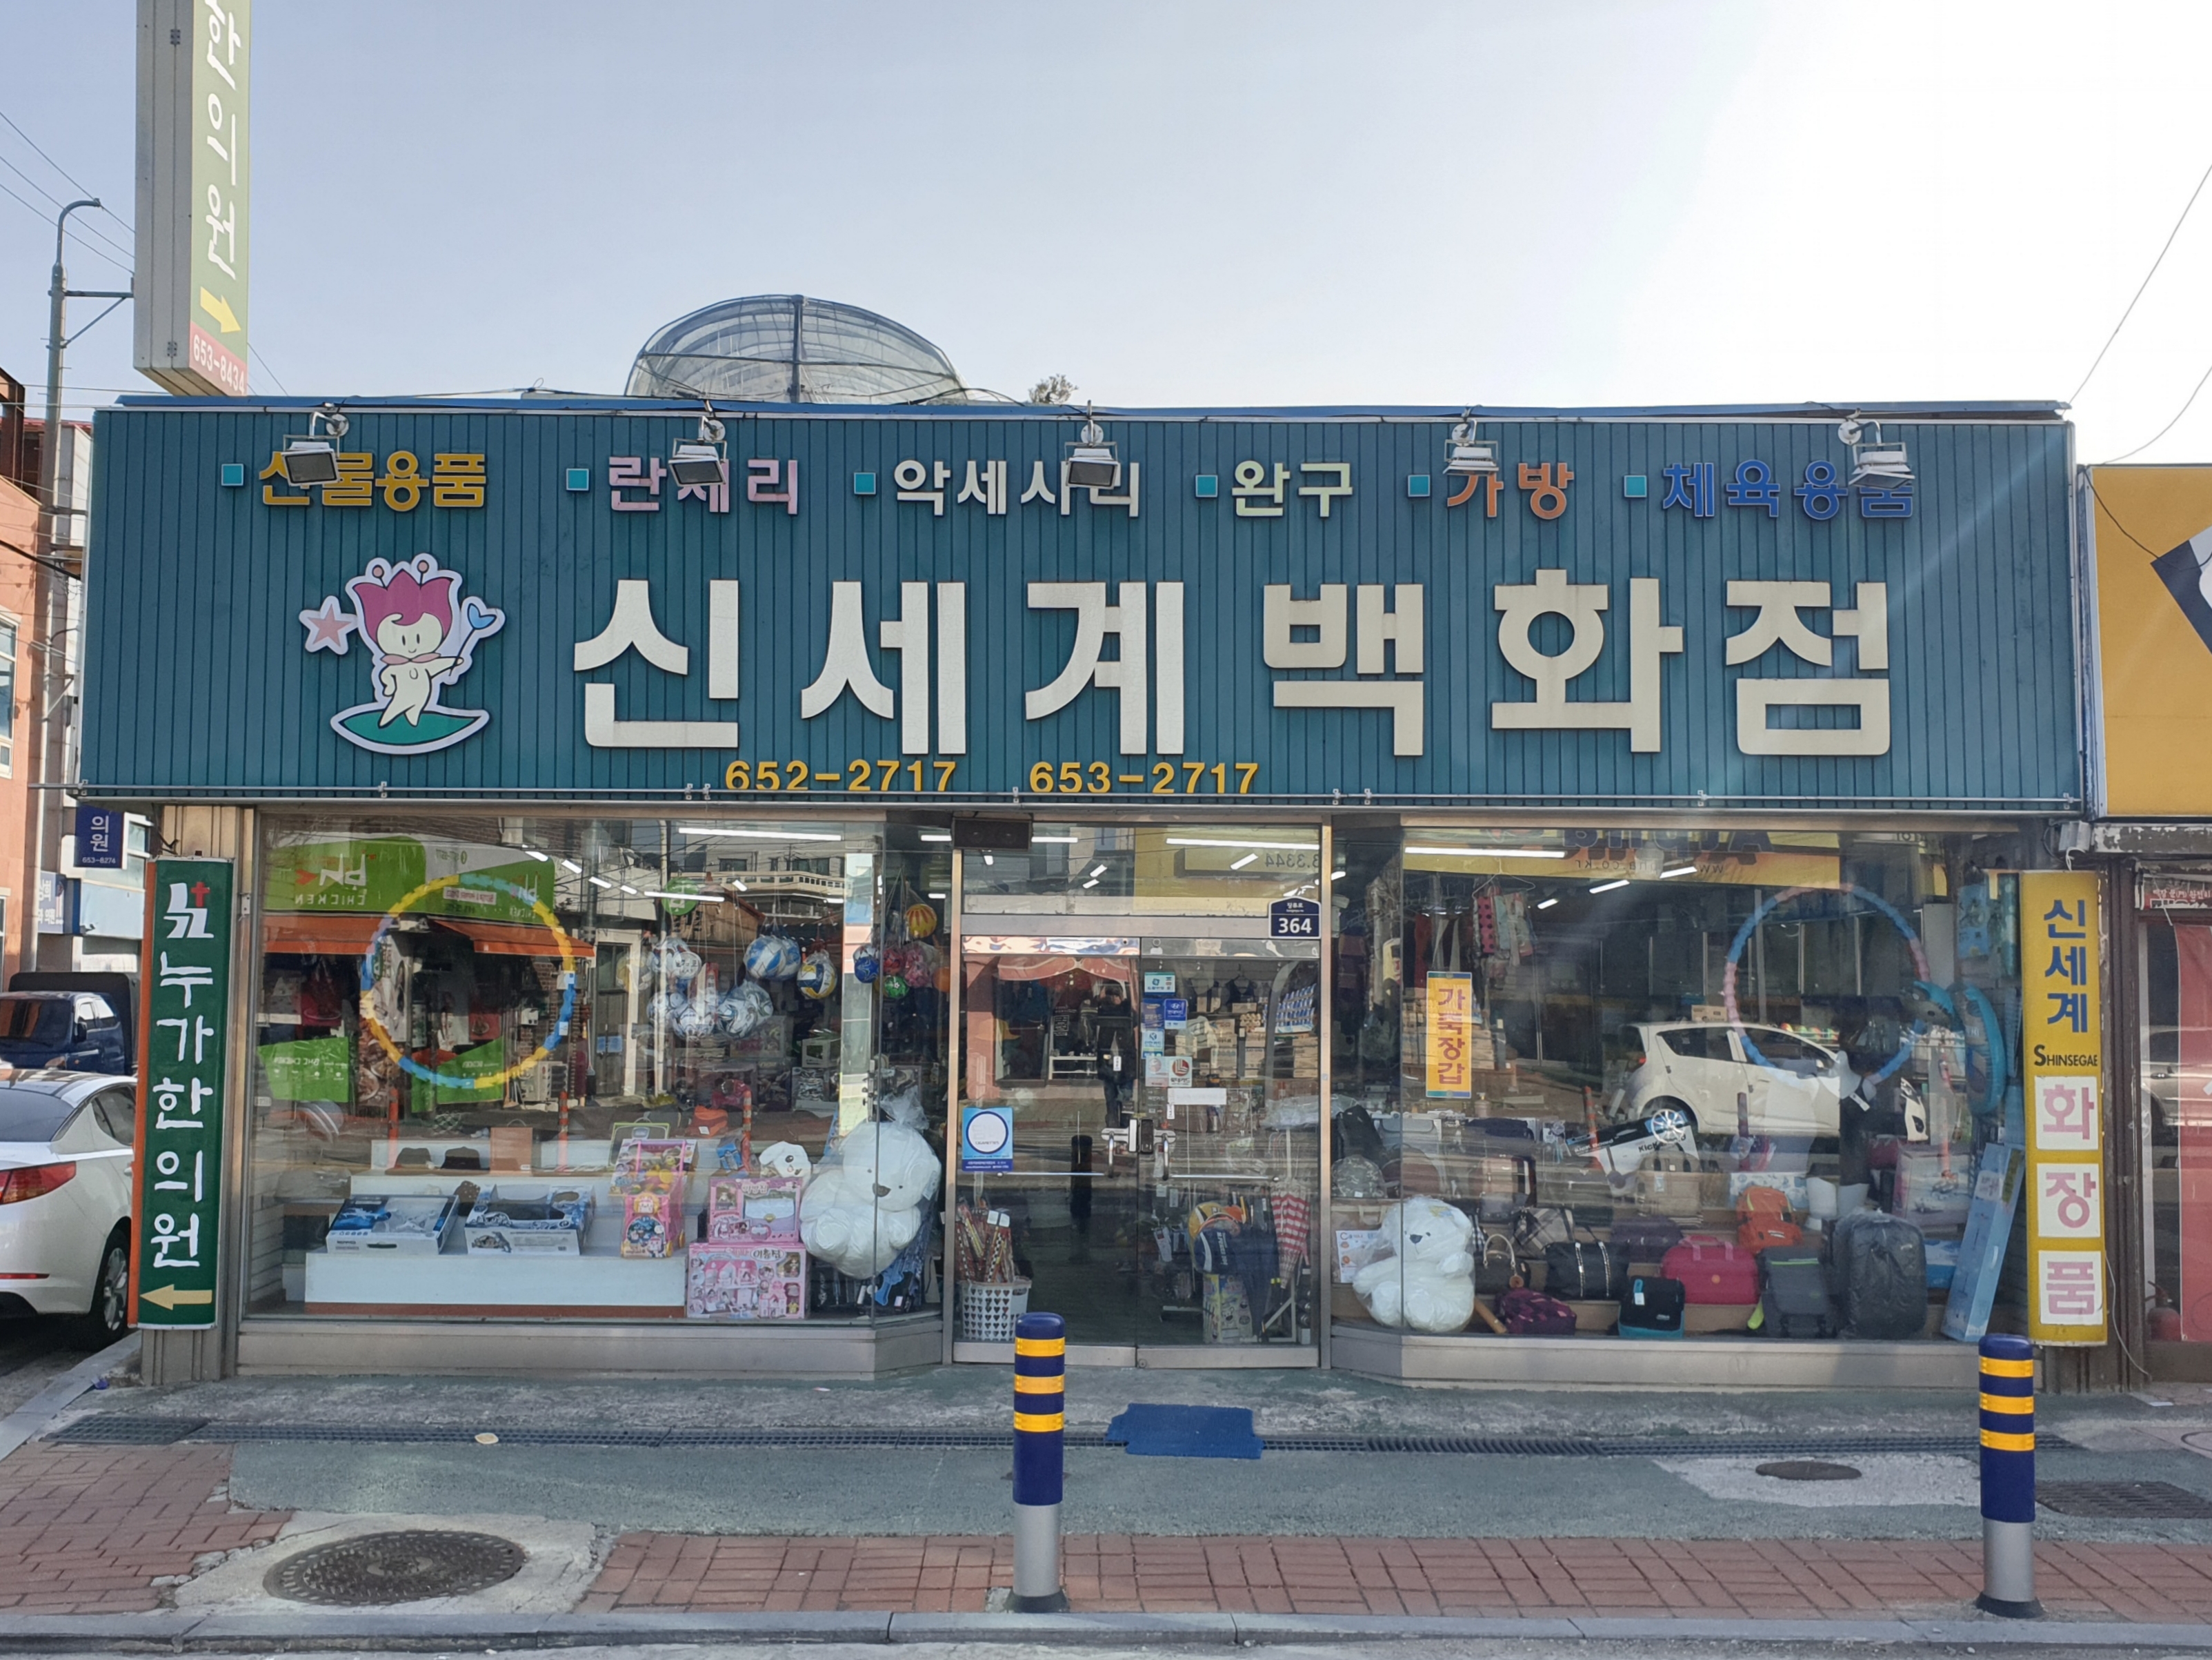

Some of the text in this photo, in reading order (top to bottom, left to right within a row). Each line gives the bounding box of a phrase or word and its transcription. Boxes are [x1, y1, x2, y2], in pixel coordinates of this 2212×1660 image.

[192, 333, 246, 395] 653-8434
[894, 459, 1139, 517] 악세사리
[1231, 459, 1353, 517] 완구
[1446, 462, 1575, 520] 가방
[1662, 459, 1914, 521] 체육용품
[574, 569, 1890, 755] 신세계백화점
[725, 759, 1259, 794] 652-2717 653-2717
[1278, 918, 1312, 933] 364
[2043, 899, 2088, 1034] 신세계
[2033, 1044, 2098, 1067] SHINSEGAE
[2042, 1083, 2097, 1316] 화장품
